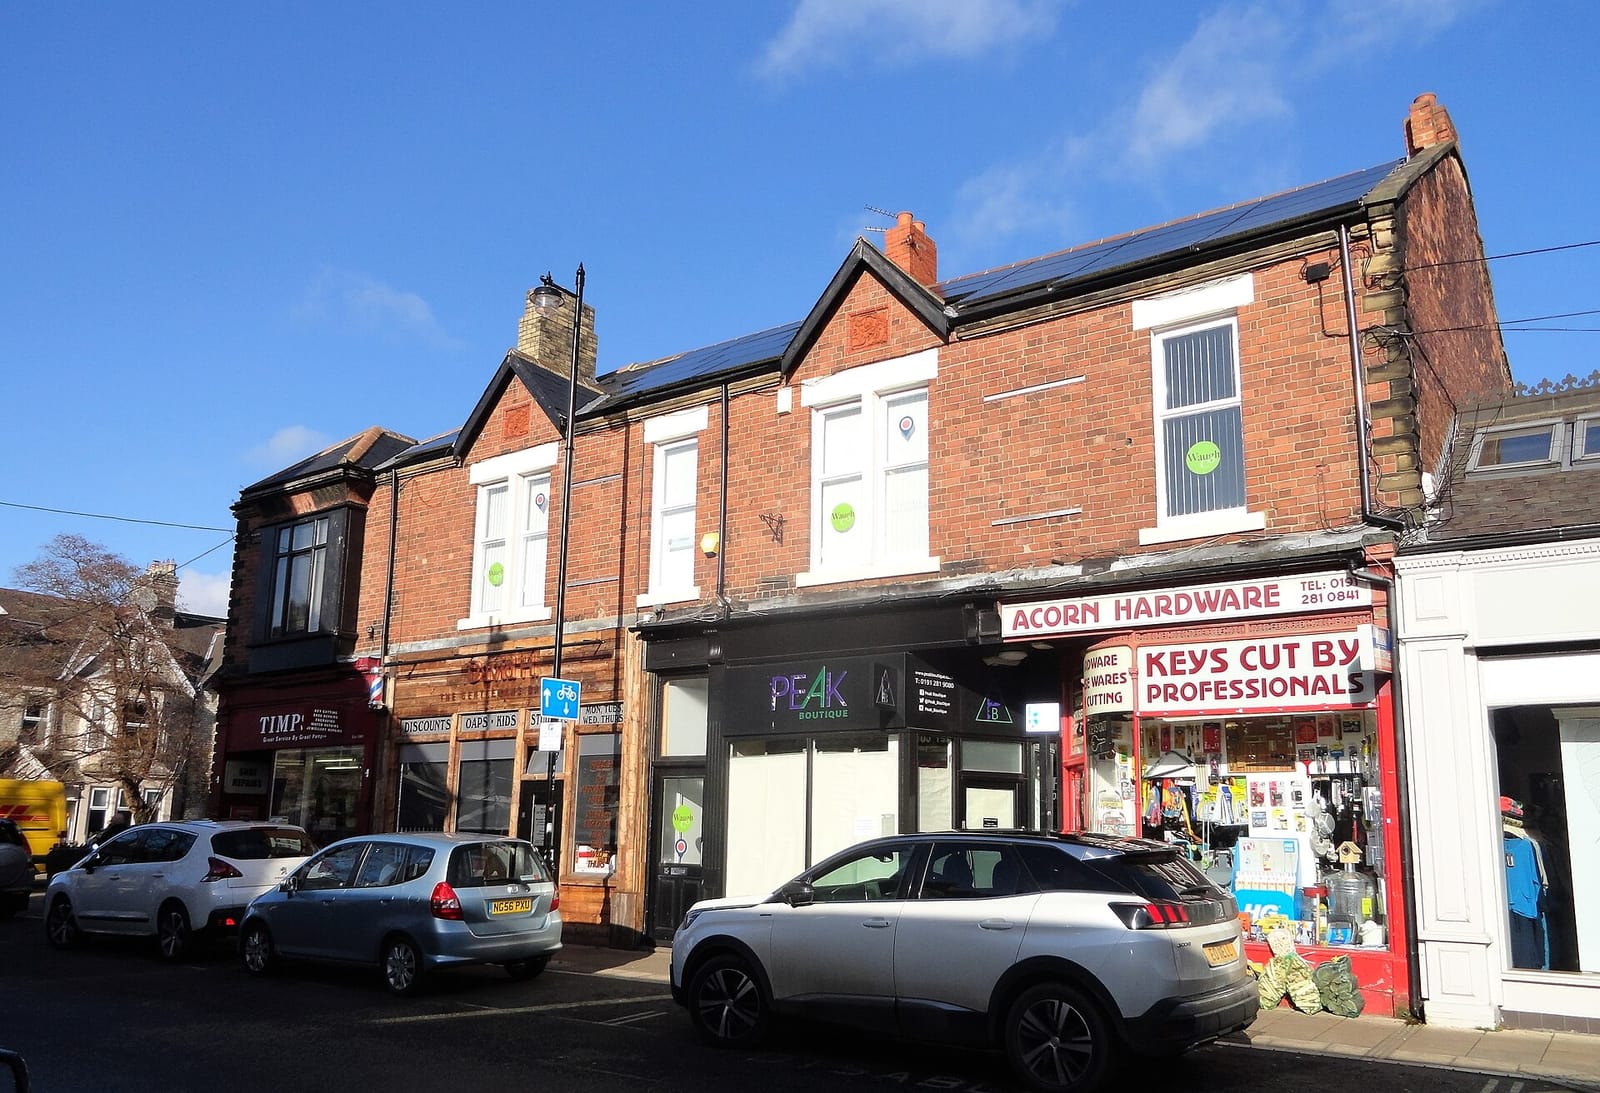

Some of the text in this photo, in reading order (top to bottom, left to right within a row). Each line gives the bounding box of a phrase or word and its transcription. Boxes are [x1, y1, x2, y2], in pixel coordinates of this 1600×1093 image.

[1187, 450, 1220, 462] Waugh
[1301, 580, 1326, 591] TEL:
[1302, 590, 1359, 604] 281 0841
[1012, 584, 1280, 631] ACORN HARDWARE
[1146, 647, 1229, 677] KEYS
[1240, 642, 1300, 671] CUT
[1312, 638, 1360, 668] BY
[1091, 672, 1128, 687] WARES
[770, 665, 848, 711] PEAK
[1147, 672, 1364, 704] PROFESSIONALS
[1086, 692, 1123, 708] CUTTING
[465, 716, 488, 729] OAPS
[496, 714, 517, 727] KIDS
[602, 714, 623, 724] THURS
[799, 709, 849, 720] BOUTIQUE
[404, 719, 451, 733] DISCOUNTS
[494, 900, 529, 912] NG56 PXU
[1243, 903, 1280, 919] HG
